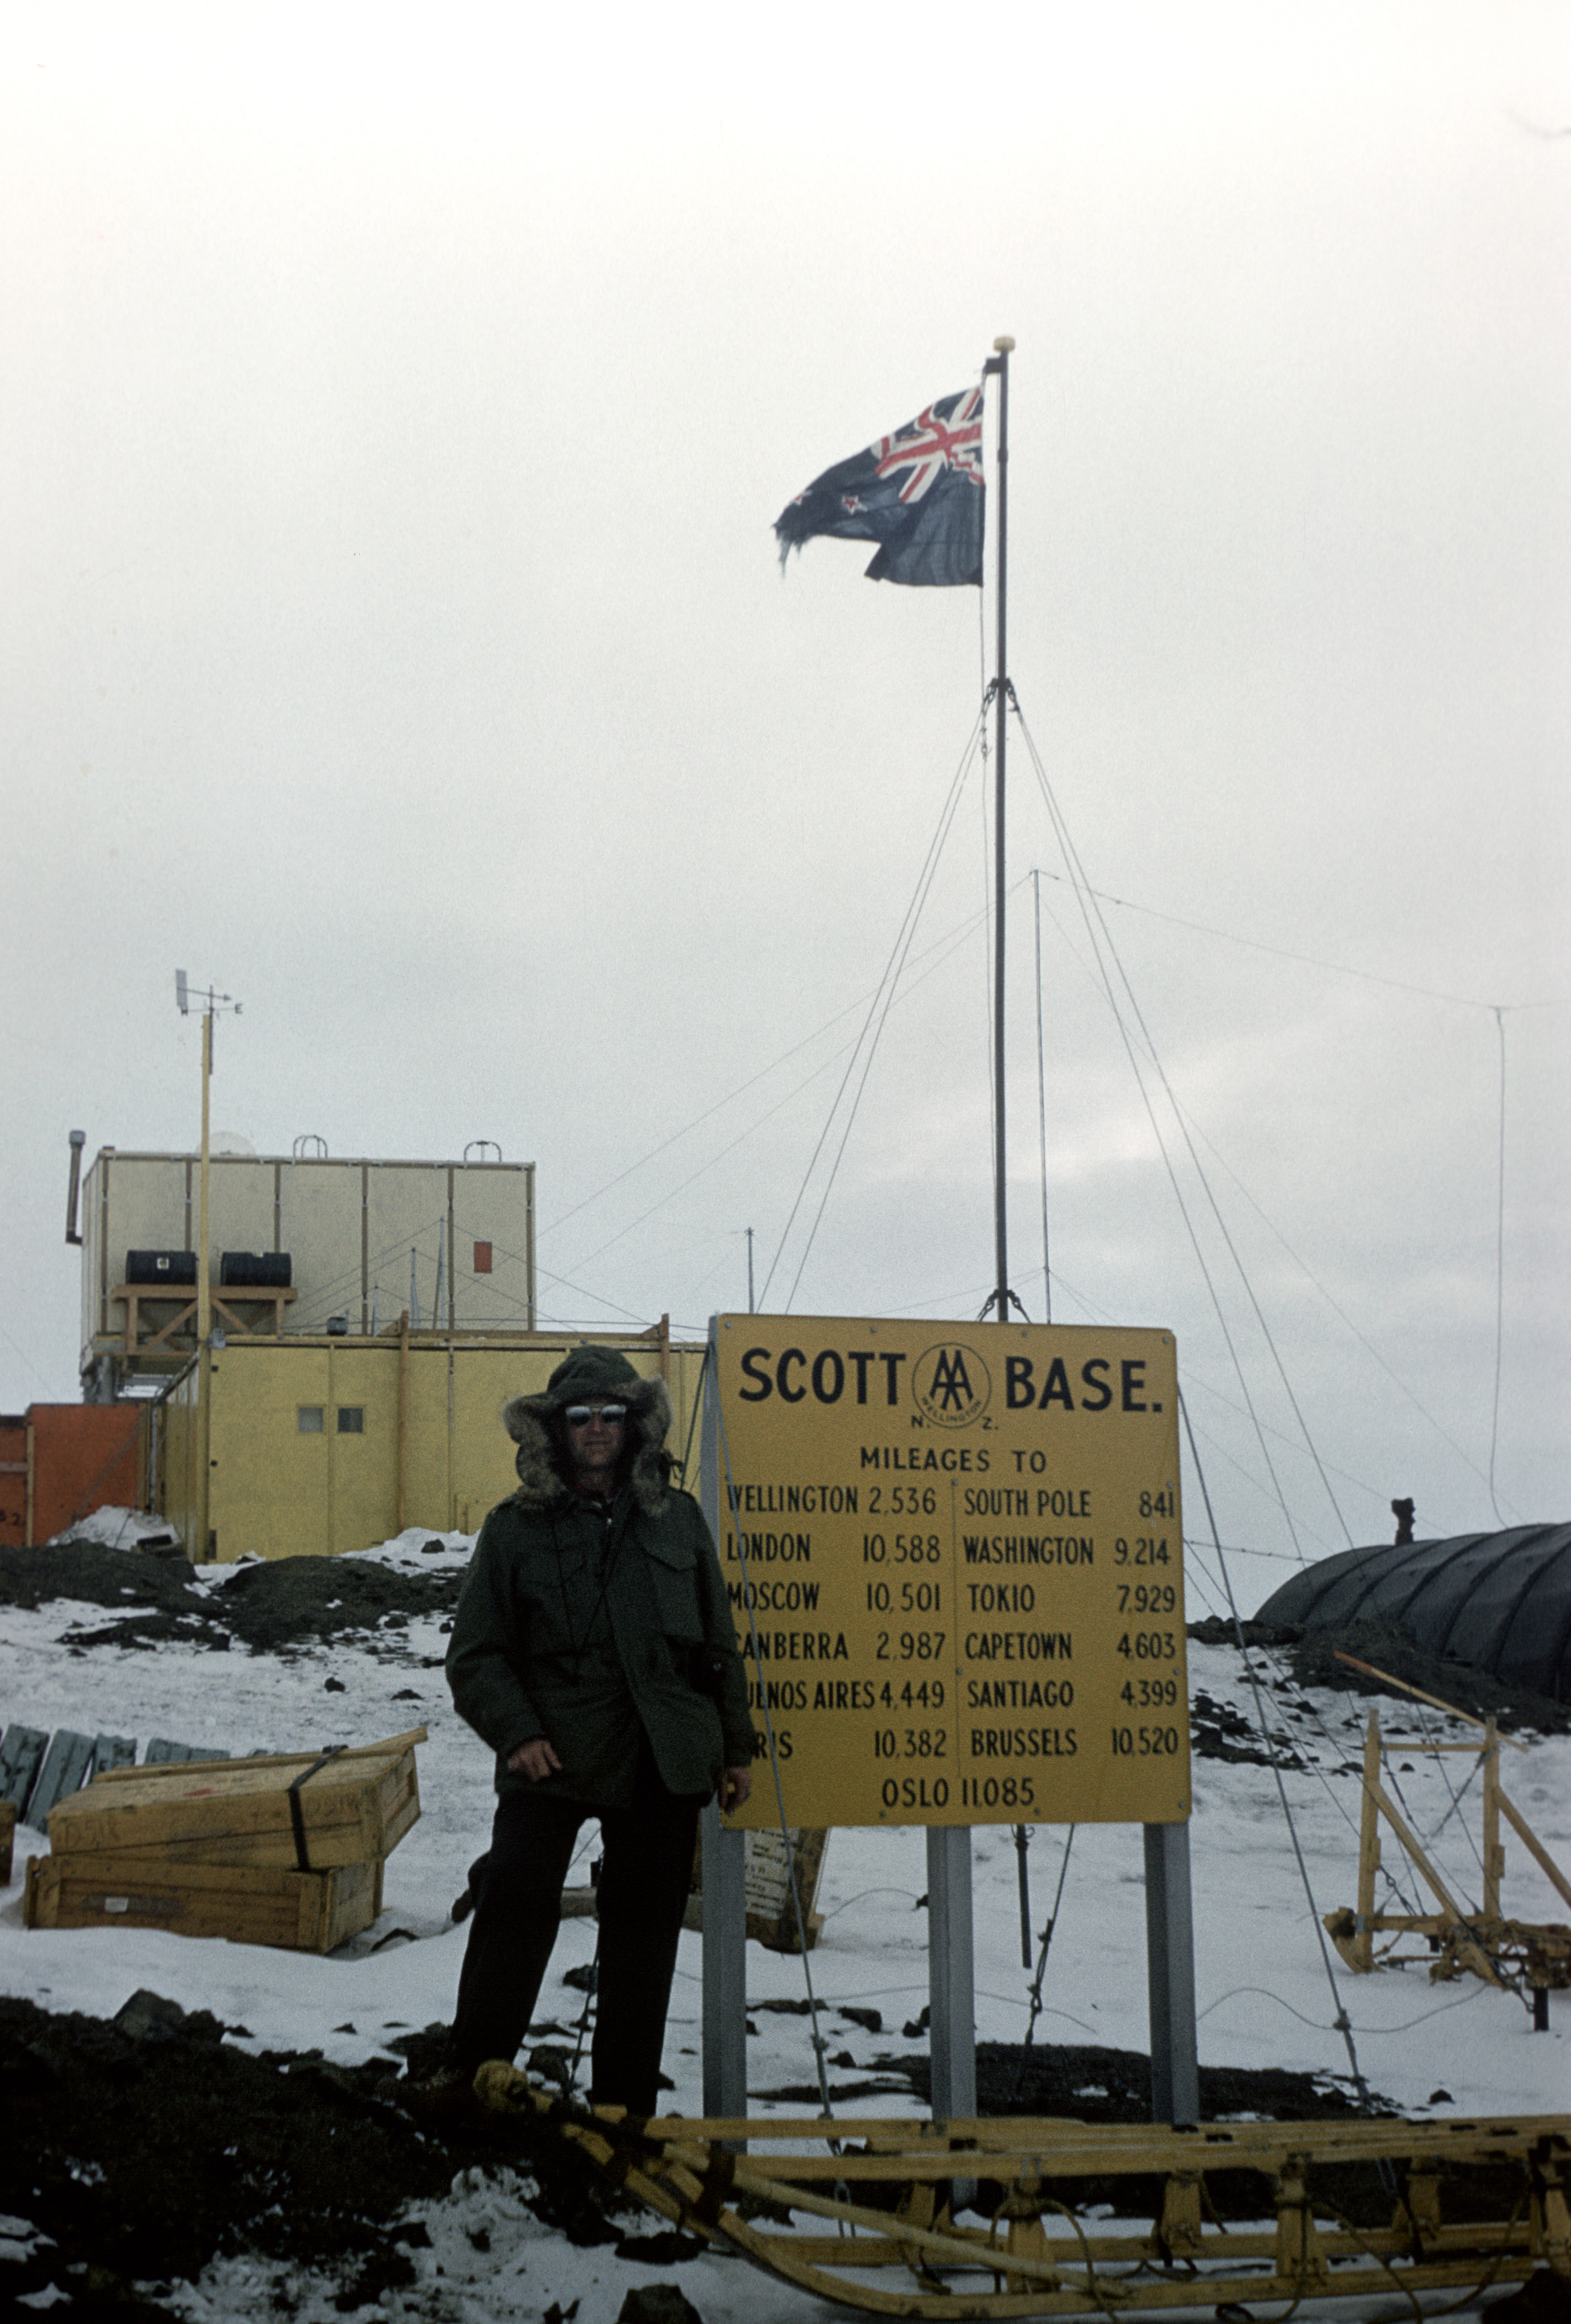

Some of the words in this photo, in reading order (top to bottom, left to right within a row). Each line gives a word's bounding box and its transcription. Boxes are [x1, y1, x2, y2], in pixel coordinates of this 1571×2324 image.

[739, 1347, 906, 1406] SCOTT
[1005, 1356, 1163, 1413] BASE.
[928, 1349, 974, 1411] AA
[861, 1447, 990, 1472] MILEAGES
[1012, 1450, 1046, 1474] TO
[727, 1484, 858, 1514] WELLINGTON
[869, 1487, 936, 1515] 2,536
[964, 1488, 1028, 1515] SOUTH
[1037, 1490, 1091, 1517] POLE
[1139, 1491, 1174, 1518] 841
[728, 1533, 810, 1562] LONDON
[863, 1534, 941, 1563] 10,588
[963, 1536, 1093, 1565] WASHINGTON
[727, 1582, 820, 1611] MOSCOW
[867, 1582, 940, 1612] 10,501
[968, 1584, 1035, 1612] TOKIO
[736, 1632, 848, 1660] ANBERRA
[876, 1631, 946, 1660] 2,987
[965, 1632, 1072, 1660] CAPETOWN
[813, 1680, 875, 1710] AIRES
[880, 1680, 945, 1708] 4,449
[968, 1680, 1074, 1708] SANTIAGO
[875, 1729, 946, 1758] 10,382
[971, 1728, 1077, 1757] BRUSSELS
[882, 1778, 949, 1808] OSLO
